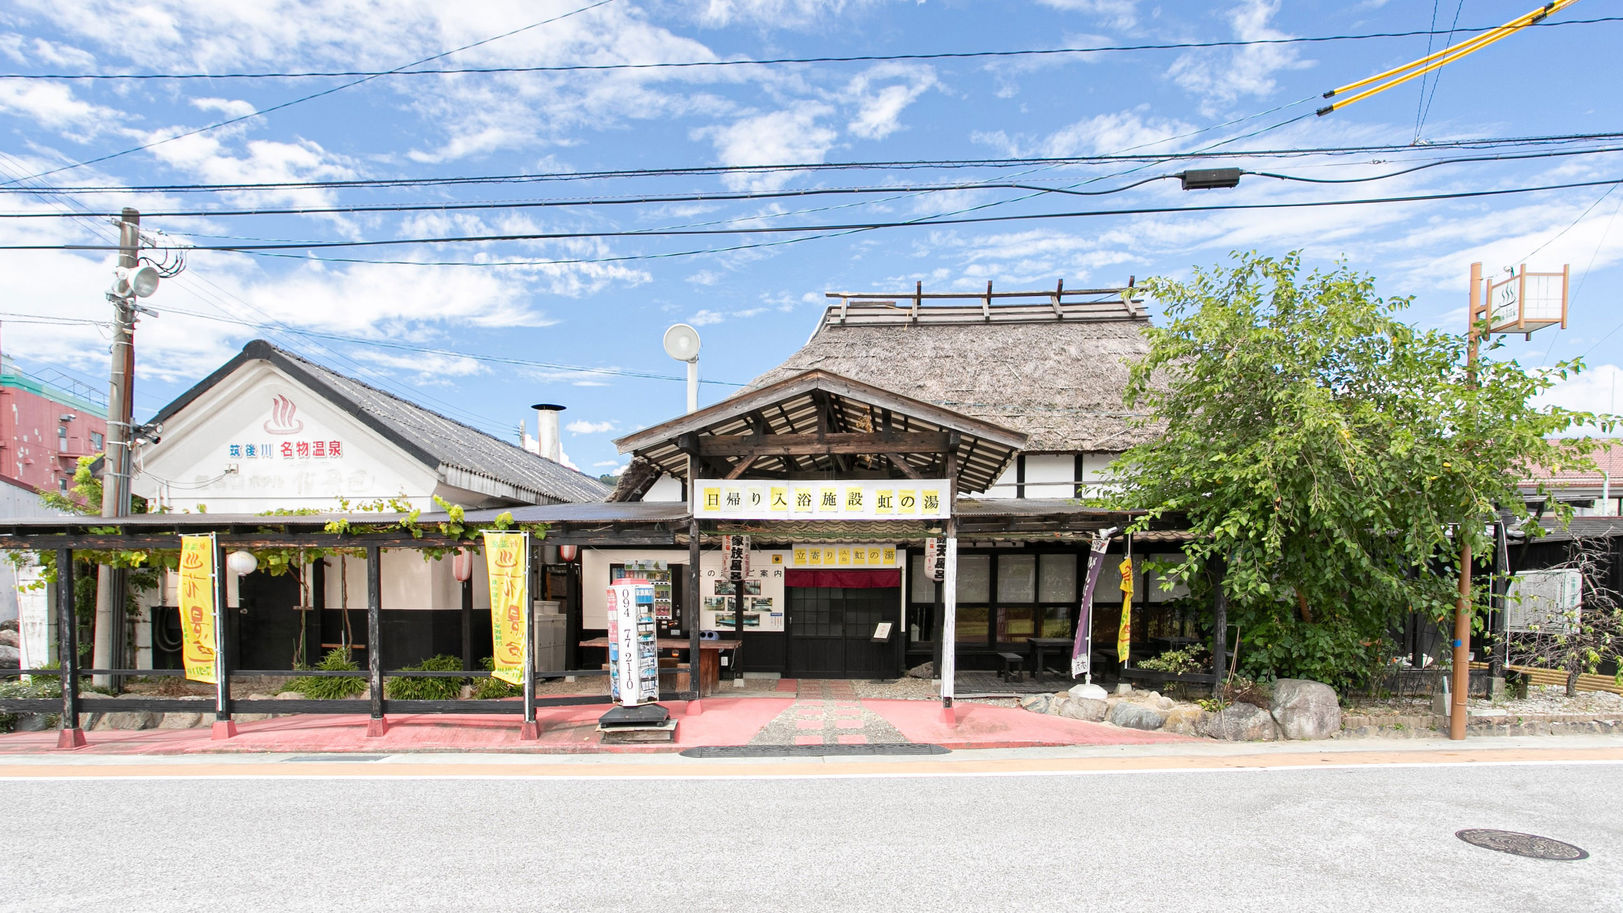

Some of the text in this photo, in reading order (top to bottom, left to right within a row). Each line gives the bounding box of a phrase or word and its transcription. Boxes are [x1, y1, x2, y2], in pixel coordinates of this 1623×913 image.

[229, 440, 342, 457] 筑後川 名物温泉
[707, 491, 940, 509] 日帰り入浴施設 虹の湯
